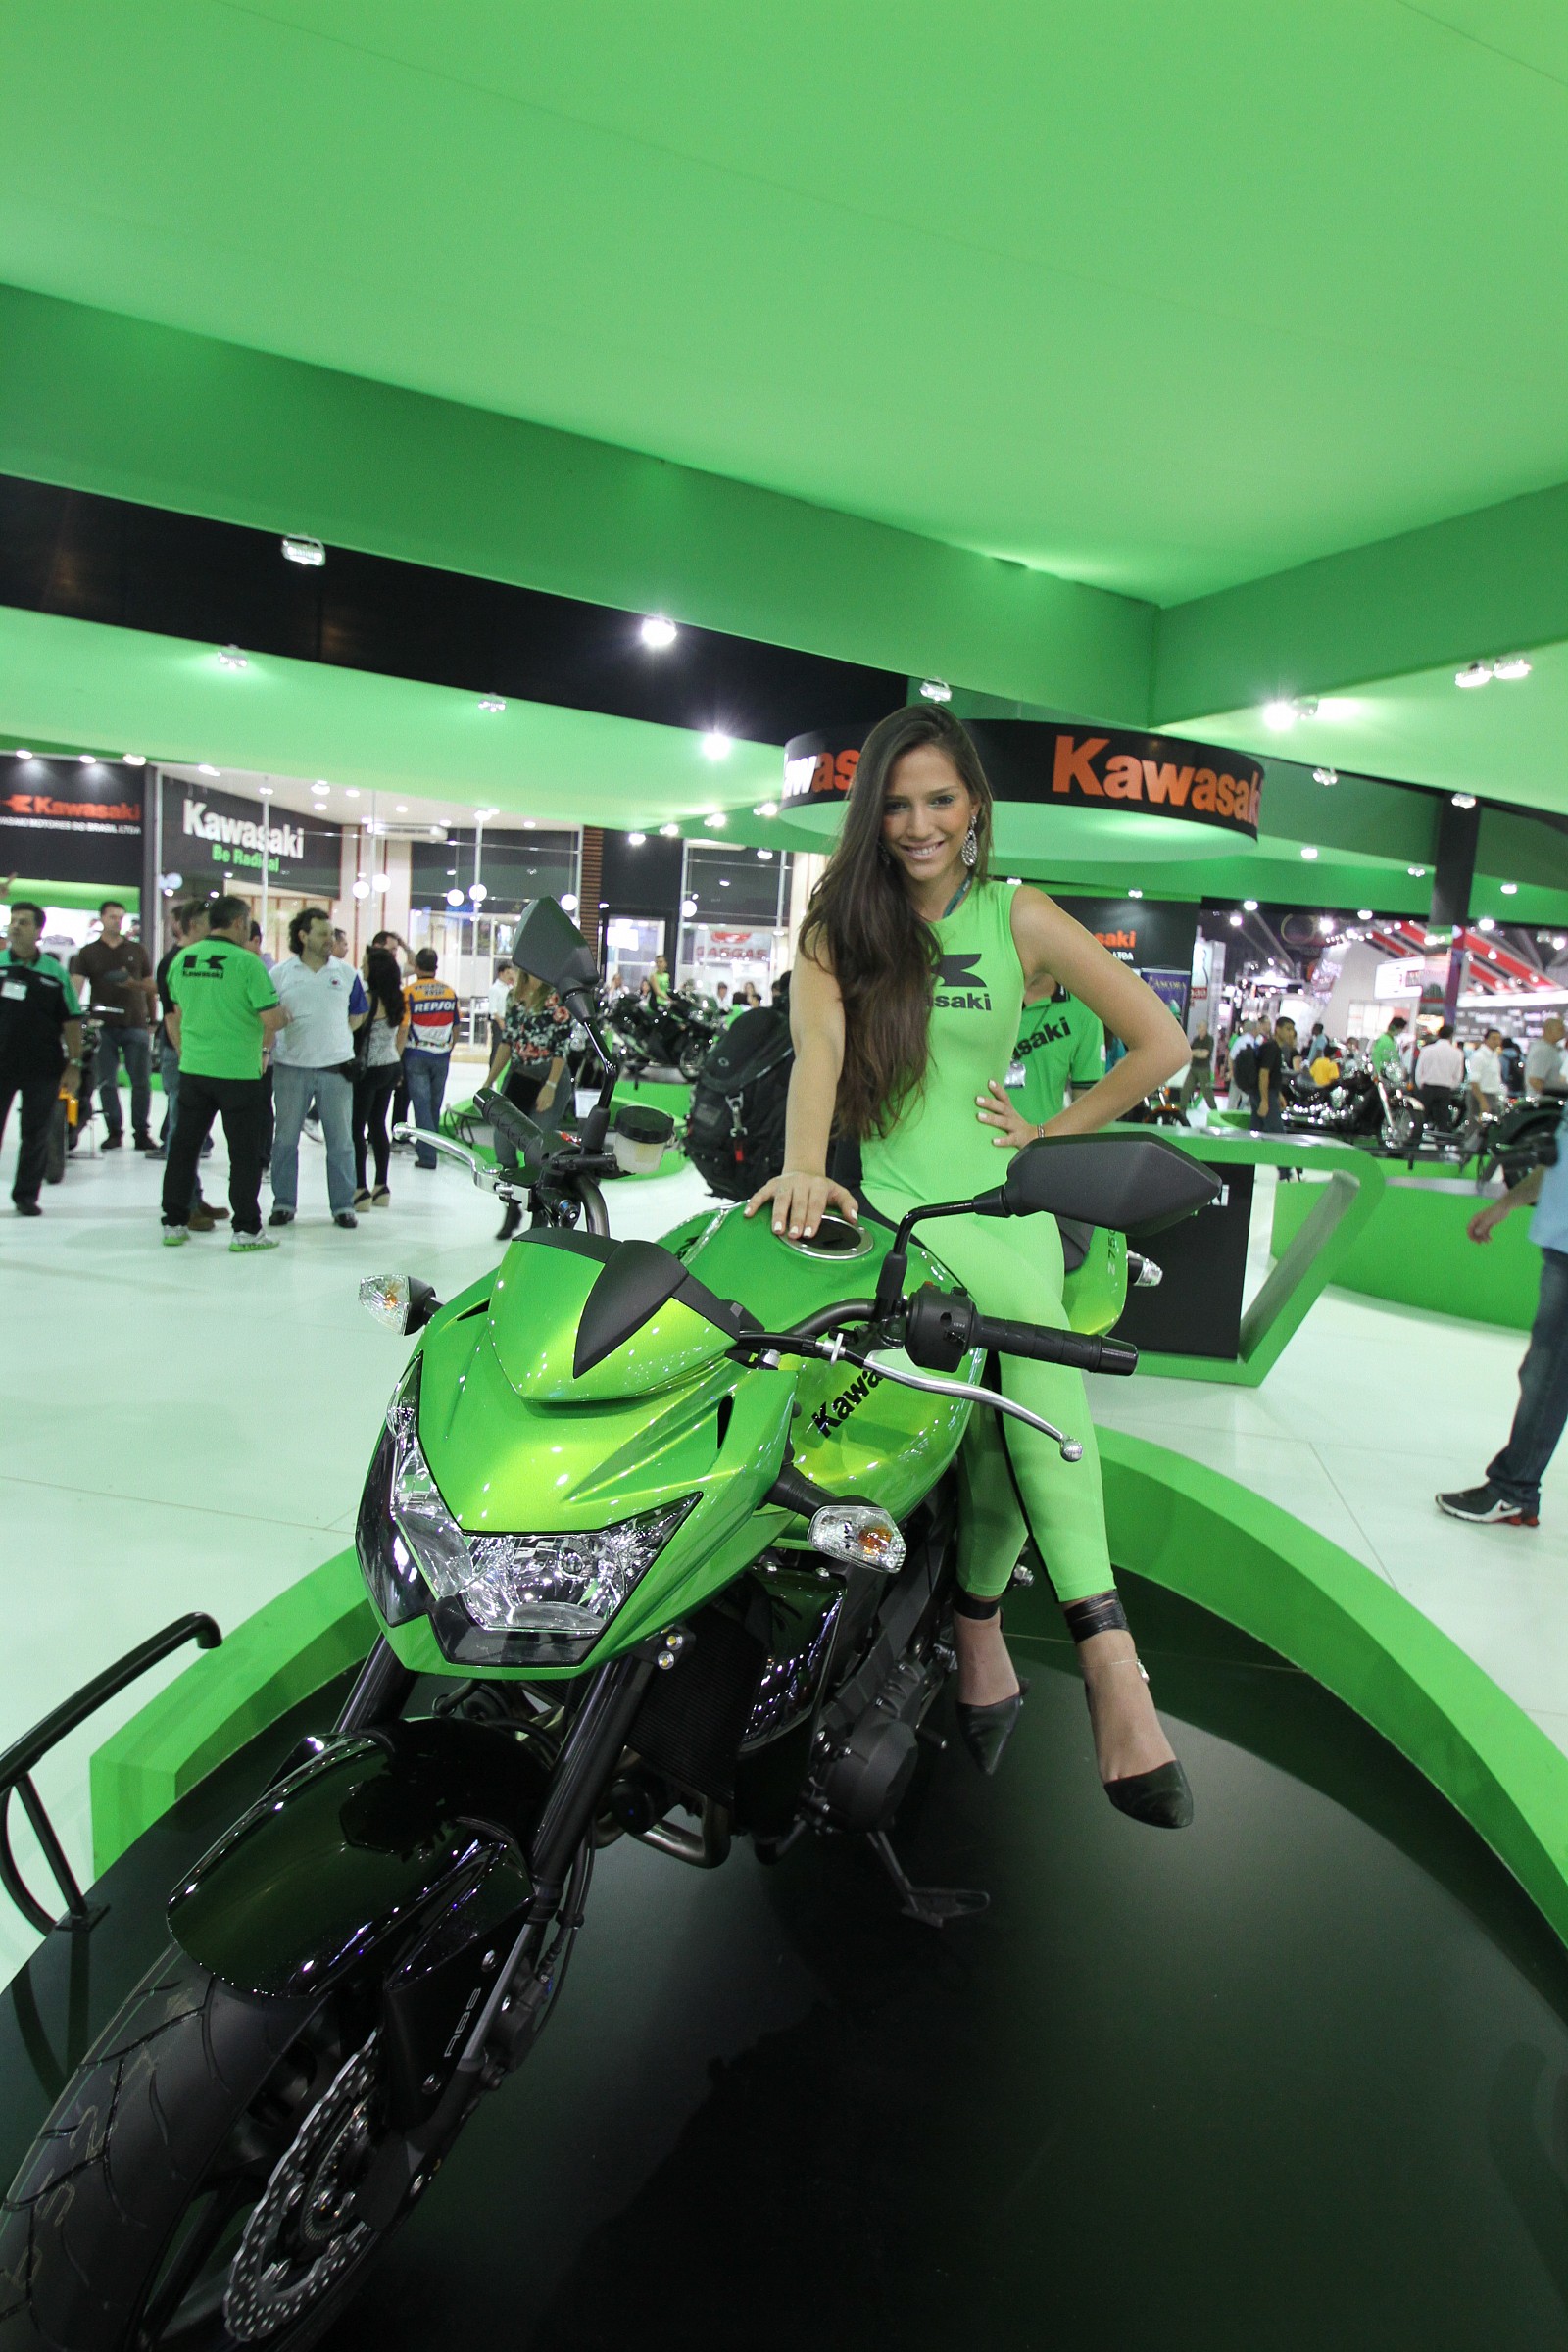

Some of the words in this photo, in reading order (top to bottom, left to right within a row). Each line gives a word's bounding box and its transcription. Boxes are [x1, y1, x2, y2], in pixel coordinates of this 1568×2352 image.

[1052, 734, 1261, 827] Kawasak
[32, 794, 140, 821] Kawasaki
[29, 817, 72, 832] MOTORES
[182, 798, 304, 859] Kawasaki
[212, 843, 231, 862] Be
[927, 993, 992, 1010] saki
[444, 1987, 482, 2057] ABS
